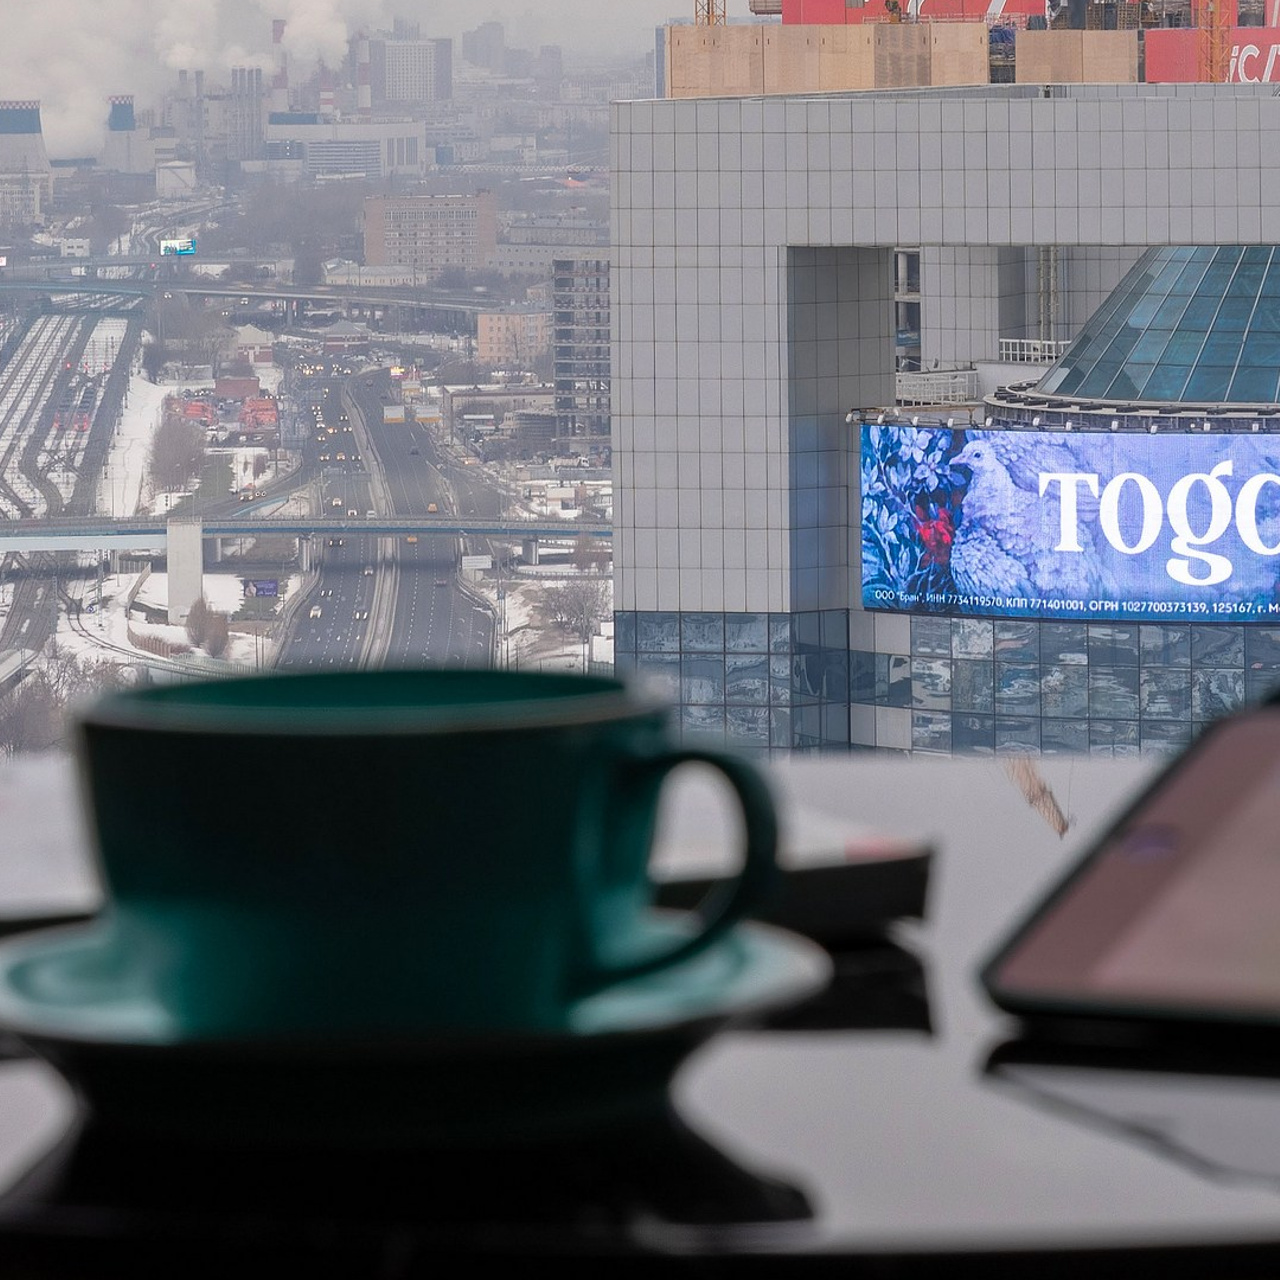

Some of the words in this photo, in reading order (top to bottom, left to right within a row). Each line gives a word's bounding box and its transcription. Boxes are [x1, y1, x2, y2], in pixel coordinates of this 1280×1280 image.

[875, 589, 895, 600] ООО
[926, 593, 945, 603] ИНН
[1006, 597, 1028, 608] КПП
[1030, 598, 1087, 612] 771401001,
[1089, 600, 1119, 611] ОГРН
[1122, 601, 1210, 614] 1027700373139,
[1212, 602, 1256, 614] 125167,
[1257, 604, 1266, 613] г.
